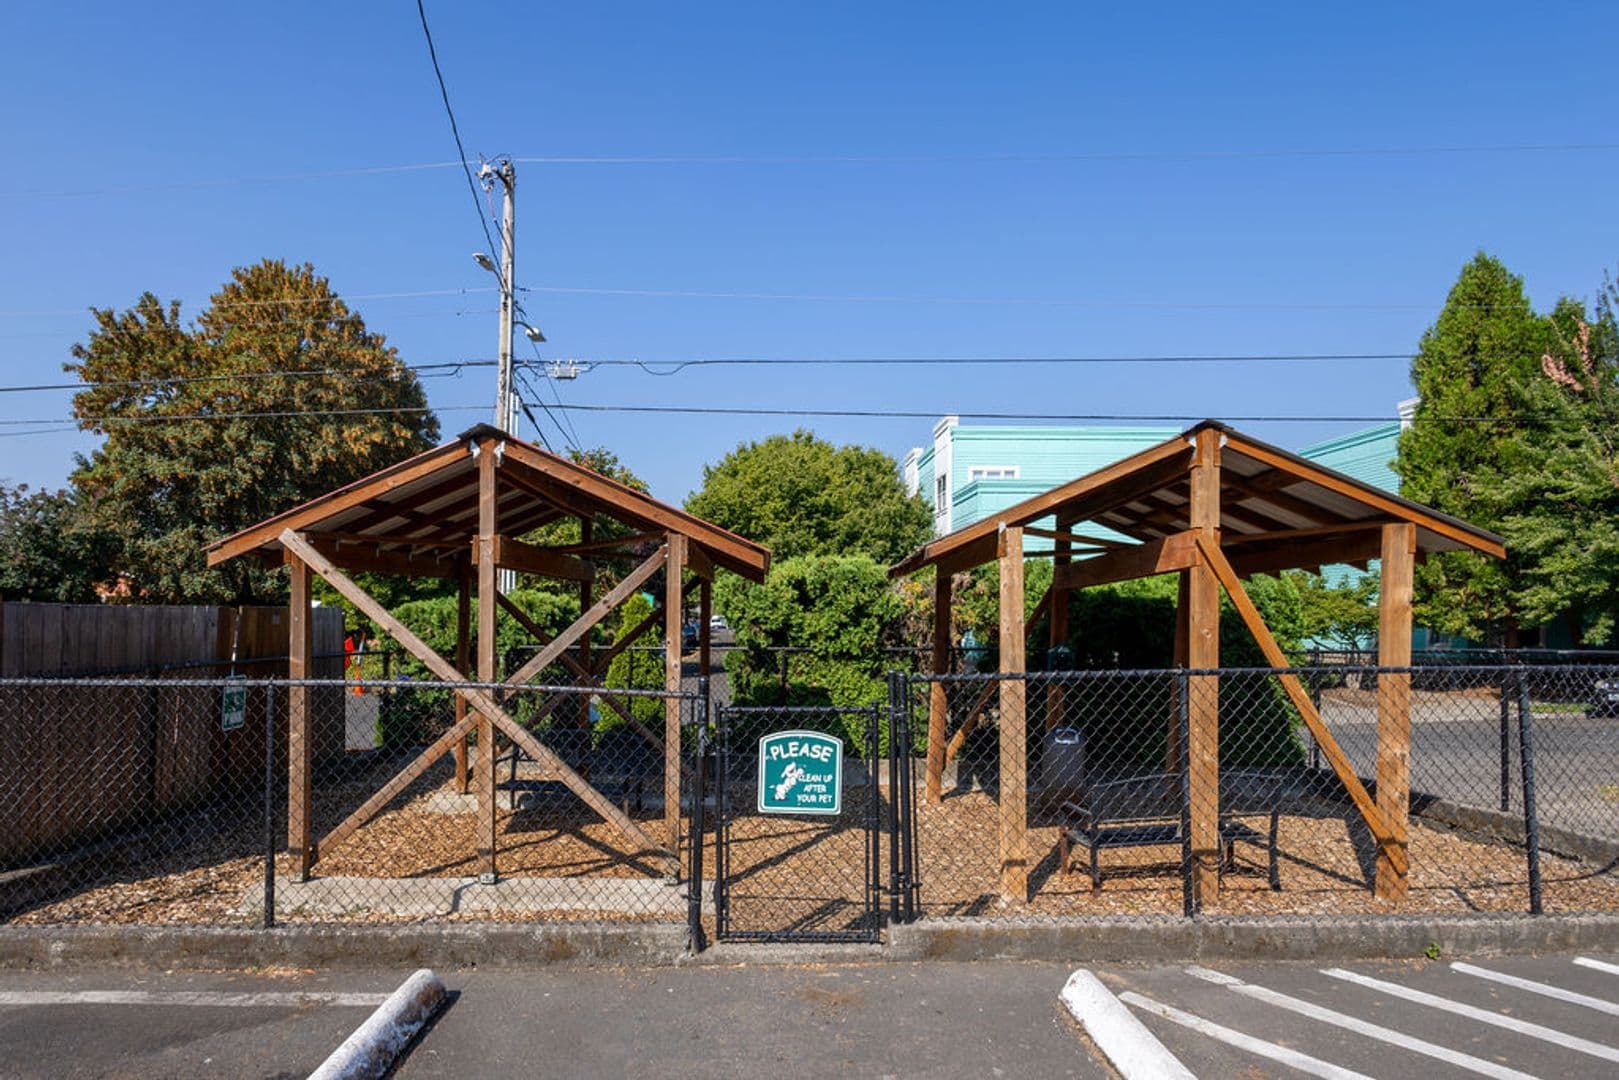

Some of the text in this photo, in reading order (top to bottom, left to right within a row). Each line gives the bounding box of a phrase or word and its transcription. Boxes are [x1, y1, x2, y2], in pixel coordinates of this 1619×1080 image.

[770, 741, 834, 763] PLEASE
[798, 773, 833, 783] CLEAN UP
[803, 784, 827, 793] AFTER
[797, 794, 833, 803] YOUR PET
